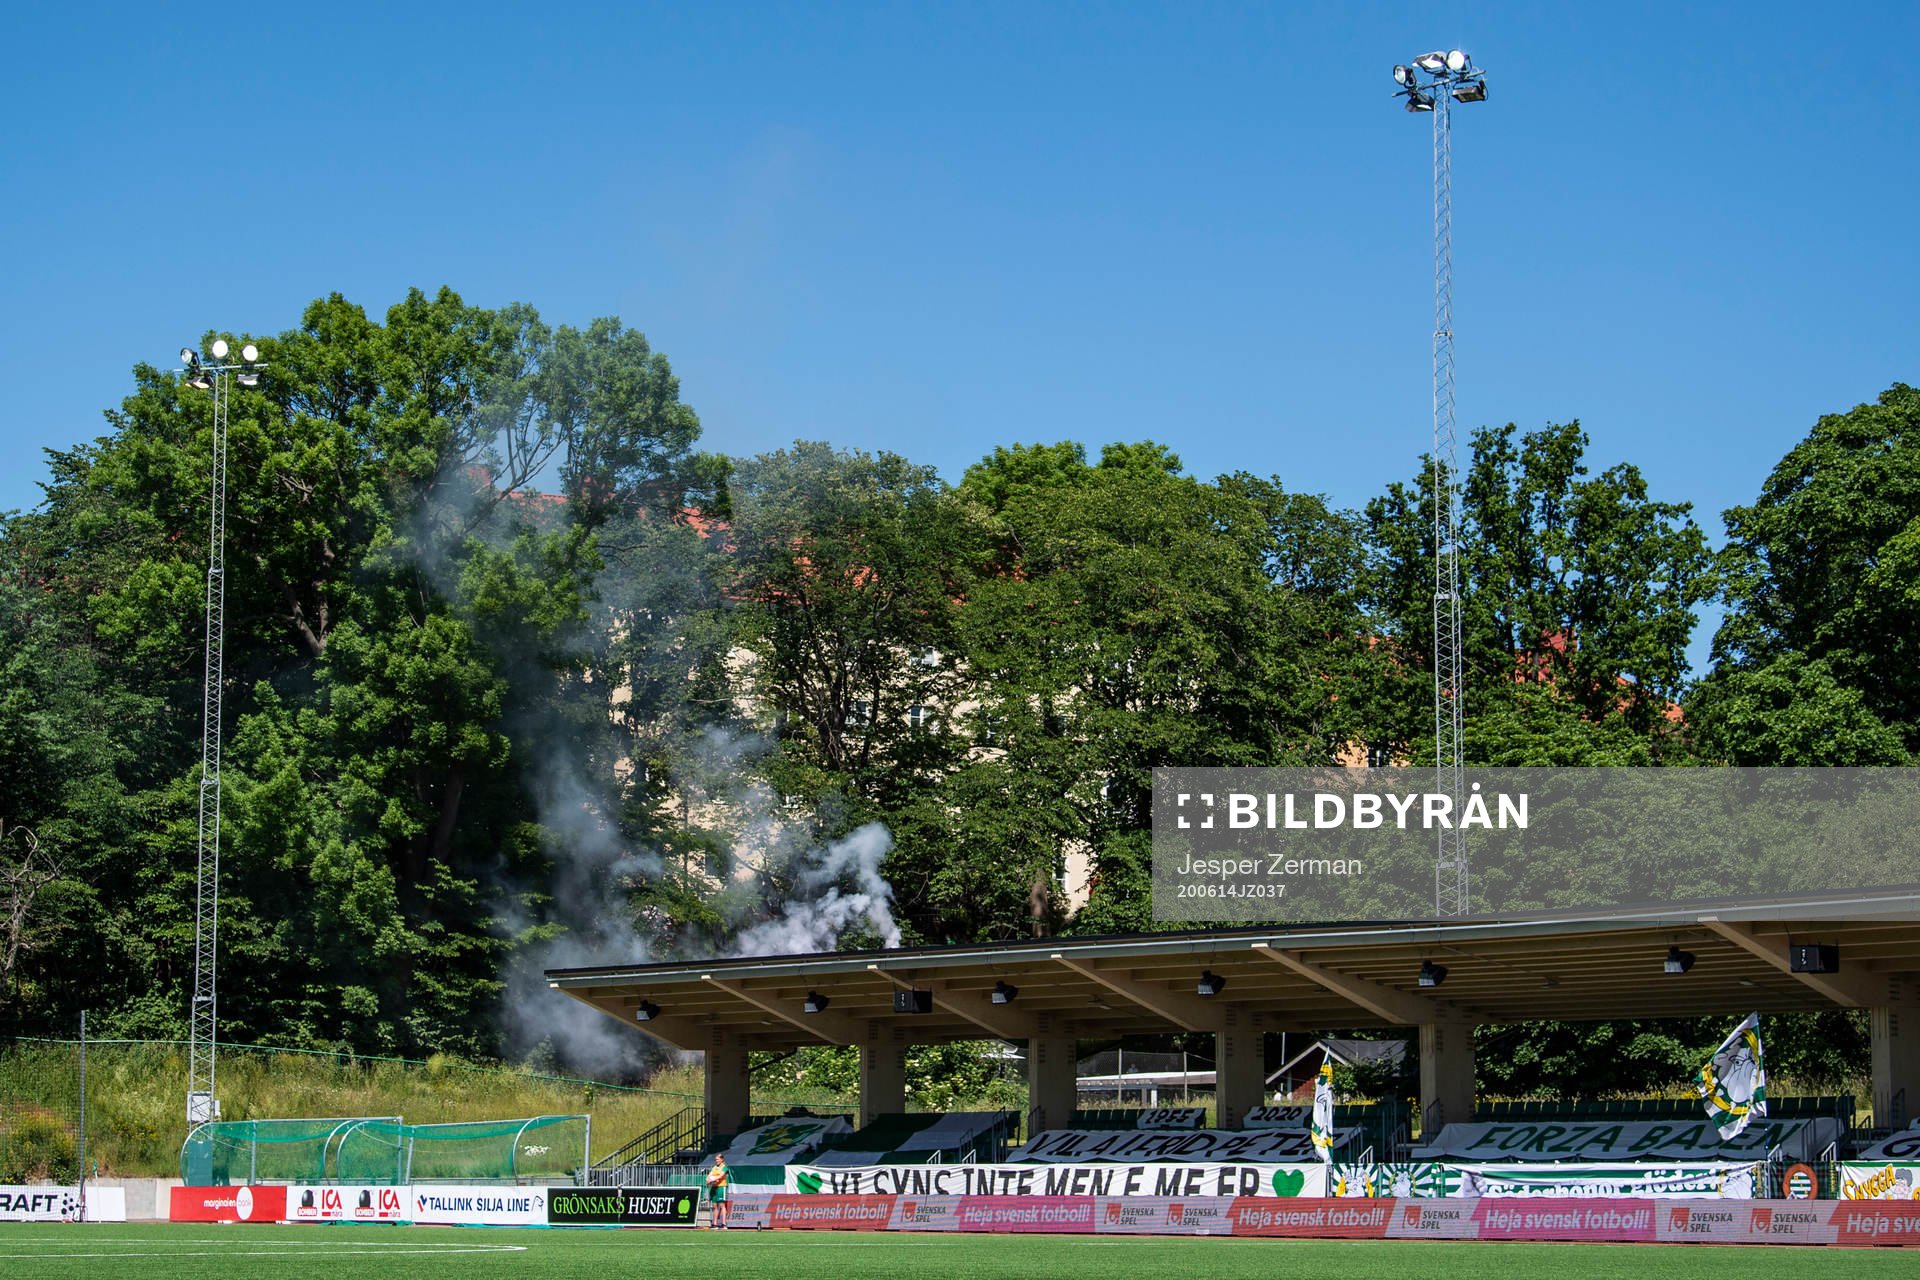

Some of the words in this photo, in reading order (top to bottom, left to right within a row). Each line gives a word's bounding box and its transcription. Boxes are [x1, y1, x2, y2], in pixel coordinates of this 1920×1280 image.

[1145, 1108, 1195, 1124] 1955
[1251, 1107, 1303, 1121] 2020
[1465, 1125, 1624, 1152] FORZA
[962, 1168, 1034, 1195] INTE
[1045, 1167, 1114, 1196] MEN
[322, 1189, 342, 1209] ICA
[379, 1189, 400, 1210] ICA
[429, 1197, 472, 1211] TALLINK
[476, 1198, 503, 1211] SILJA
[507, 1198, 530, 1212] LINE
[627, 1197, 675, 1215] HUSET
[775, 1203, 801, 1222] Heja
[803, 1203, 842, 1219] svensk
[844, 1203, 888, 1220] fotboll!
[916, 1206, 946, 1214] SVENSKA
[964, 1206, 993, 1226] Heja
[995, 1205, 1039, 1222] svensk
[1041, 1204, 1091, 1222] fotboll!
[1122, 1208, 1154, 1216] SVENSKA
[1184, 1208, 1218, 1217] SVENSKA
[1423, 1210, 1460, 1219] SVENSKA
[1691, 1212, 1733, 1222] SVENSKA
[1120, 1217, 1137, 1225] SPEL
[1182, 1217, 1200, 1226] SPEL
[1239, 1207, 1271, 1229] Heja
[1274, 1207, 1325, 1226] svensk
[1327, 1207, 1385, 1226] fotboll!
[1421, 1221, 1440, 1229] SPEL
[1484, 1209, 1522, 1232] Heja
[1525, 1209, 1582, 1229] svensk
[1584, 1209, 1650, 1229] fotboll!
[1773, 1213, 1817, 1223] SVENSKA
[1846, 1211, 1889, 1237] Heja
[1690, 1223, 1711, 1232] SPEL
[1771, 1224, 1795, 1233] SPEL
